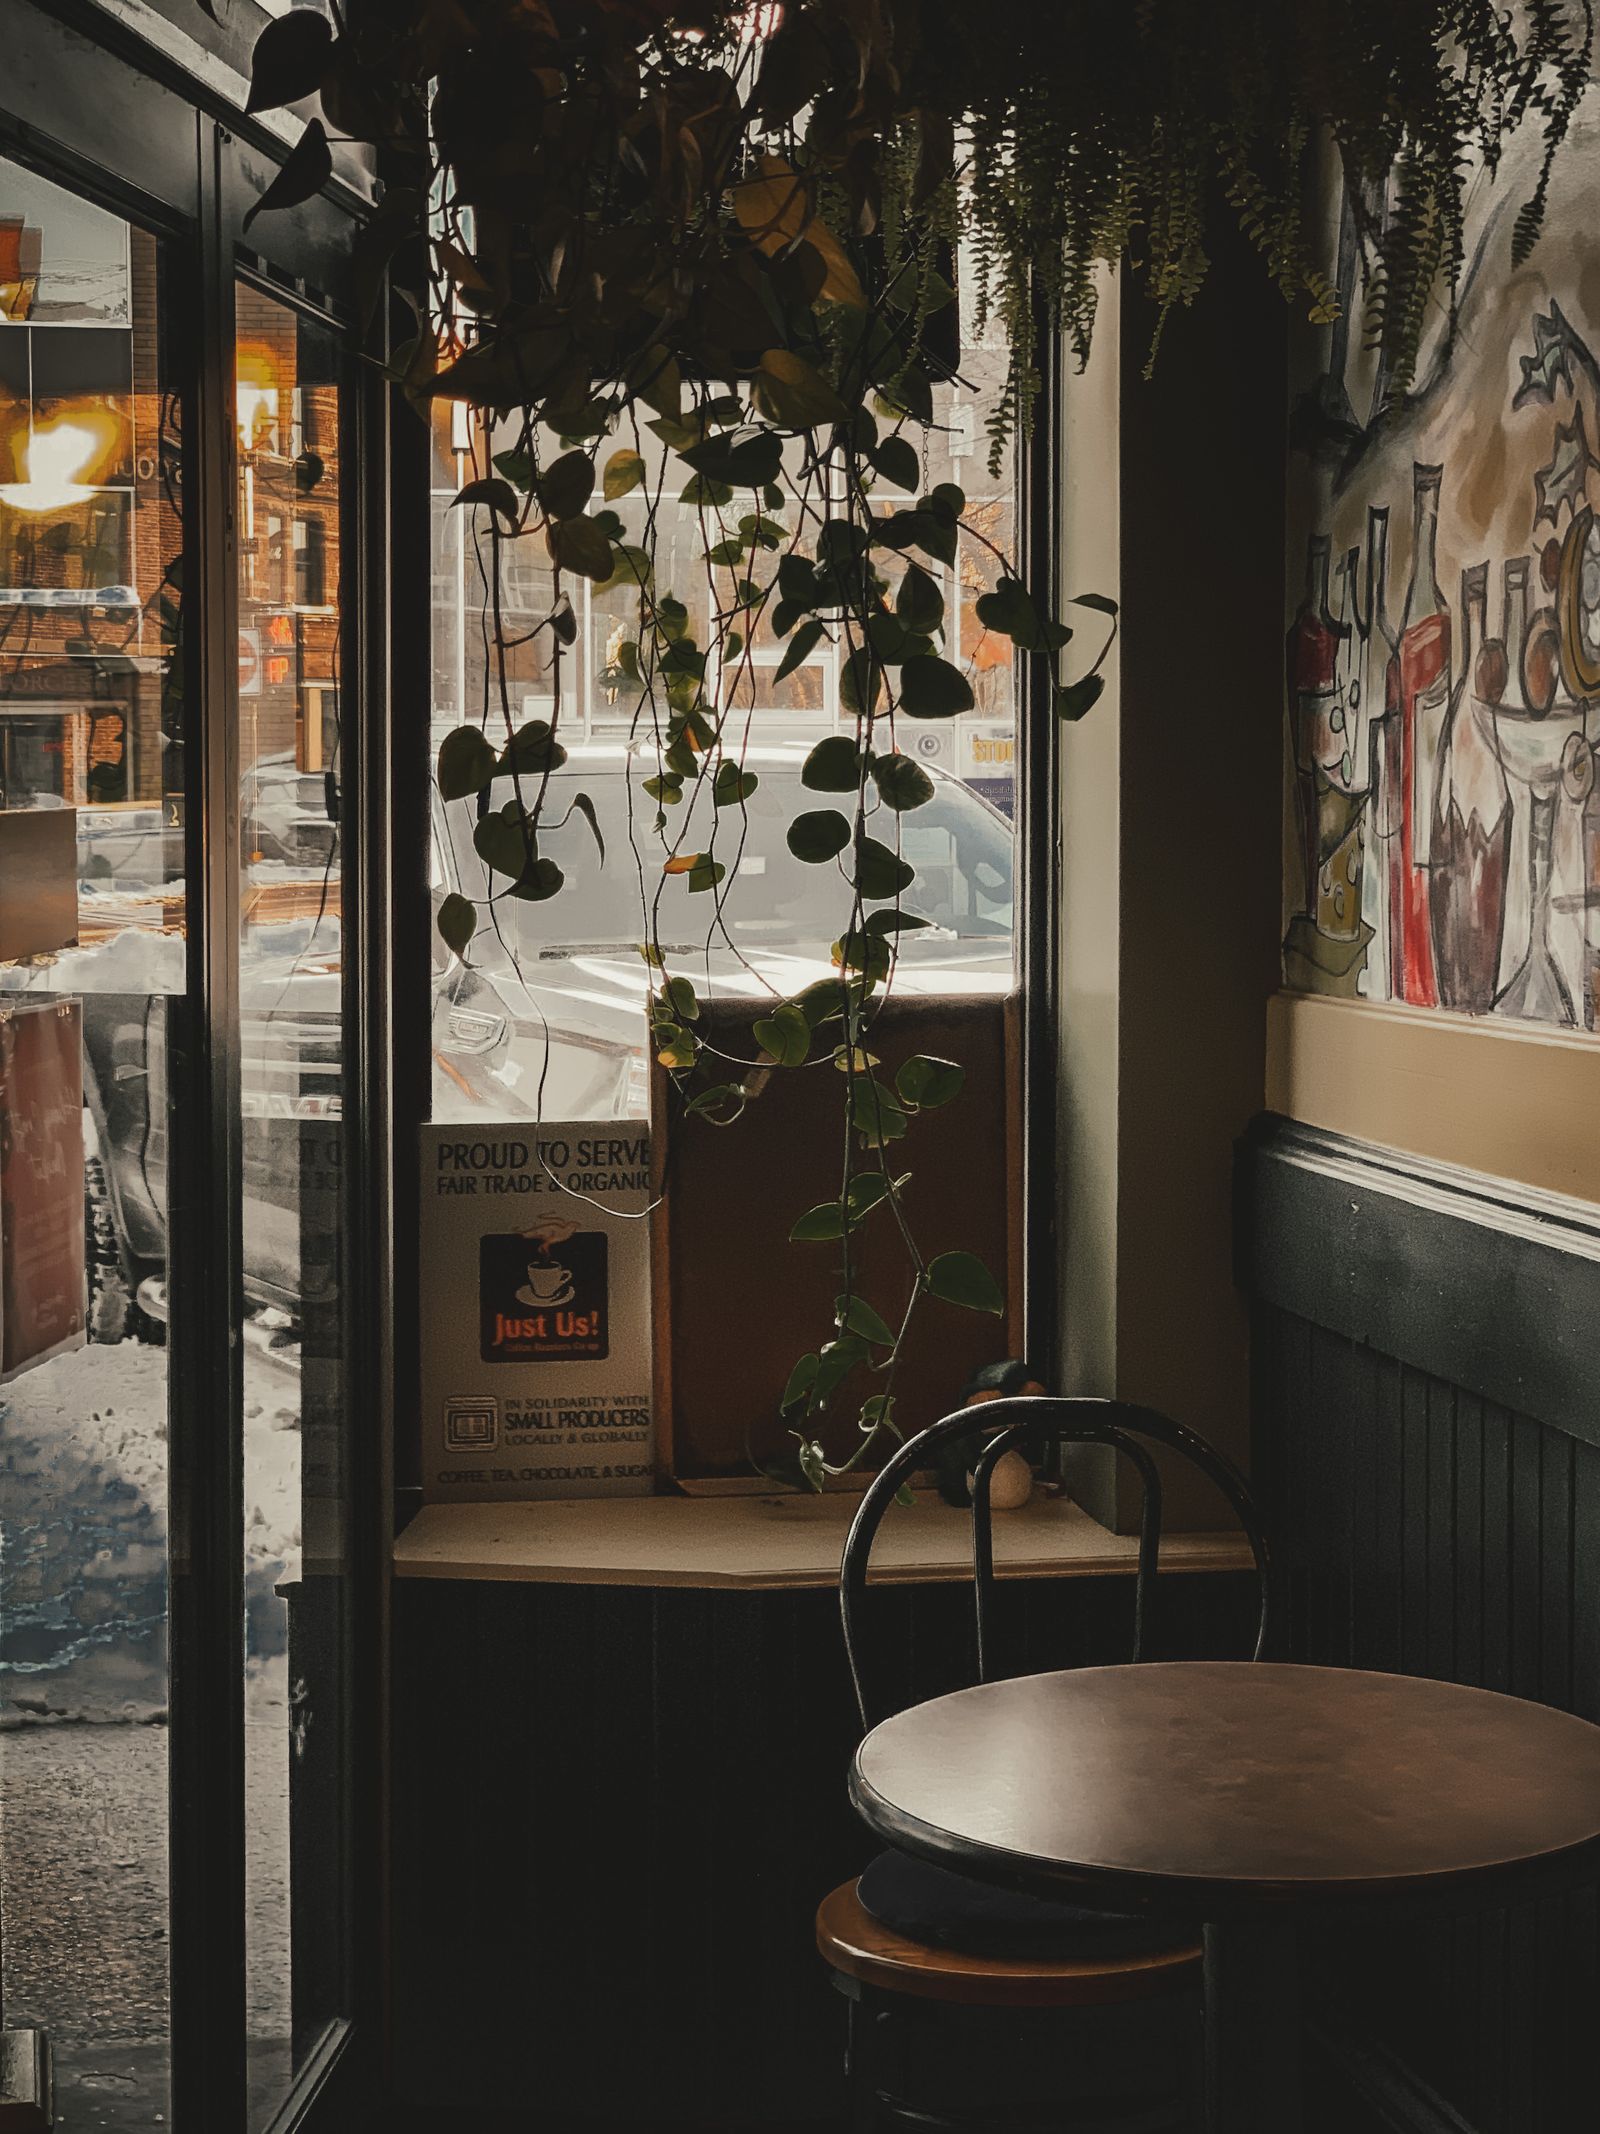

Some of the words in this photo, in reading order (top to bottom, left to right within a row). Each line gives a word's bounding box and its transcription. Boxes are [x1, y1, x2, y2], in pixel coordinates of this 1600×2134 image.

[438, 1142, 529, 1170] PROUD
[537, 1141, 570, 1168] TO
[577, 1139, 651, 1168] SERVE
[437, 1176, 477, 1195] FAIR
[483, 1174, 544, 1194] TRADE
[549, 1173, 562, 1192] &
[567, 1172, 651, 1192] ORGANIC
[491, 1312, 548, 1346] Just
[555, 1310, 599, 1337] Us!
[505, 1399, 522, 1410] IN
[525, 1397, 607, 1409] SOLIDARITY
[612, 1395, 650, 1407] WITH
[505, 1411, 554, 1430] SMALL
[558, 1408, 650, 1428] PRODUCERS
[505, 1433, 563, 1446] LOCALLY
[566, 1433, 575, 1444] &
[580, 1431, 649, 1444] GLOBALLY
[519, 1466, 599, 1481] CHOCOLATE
[602, 1465, 611, 1478] &
